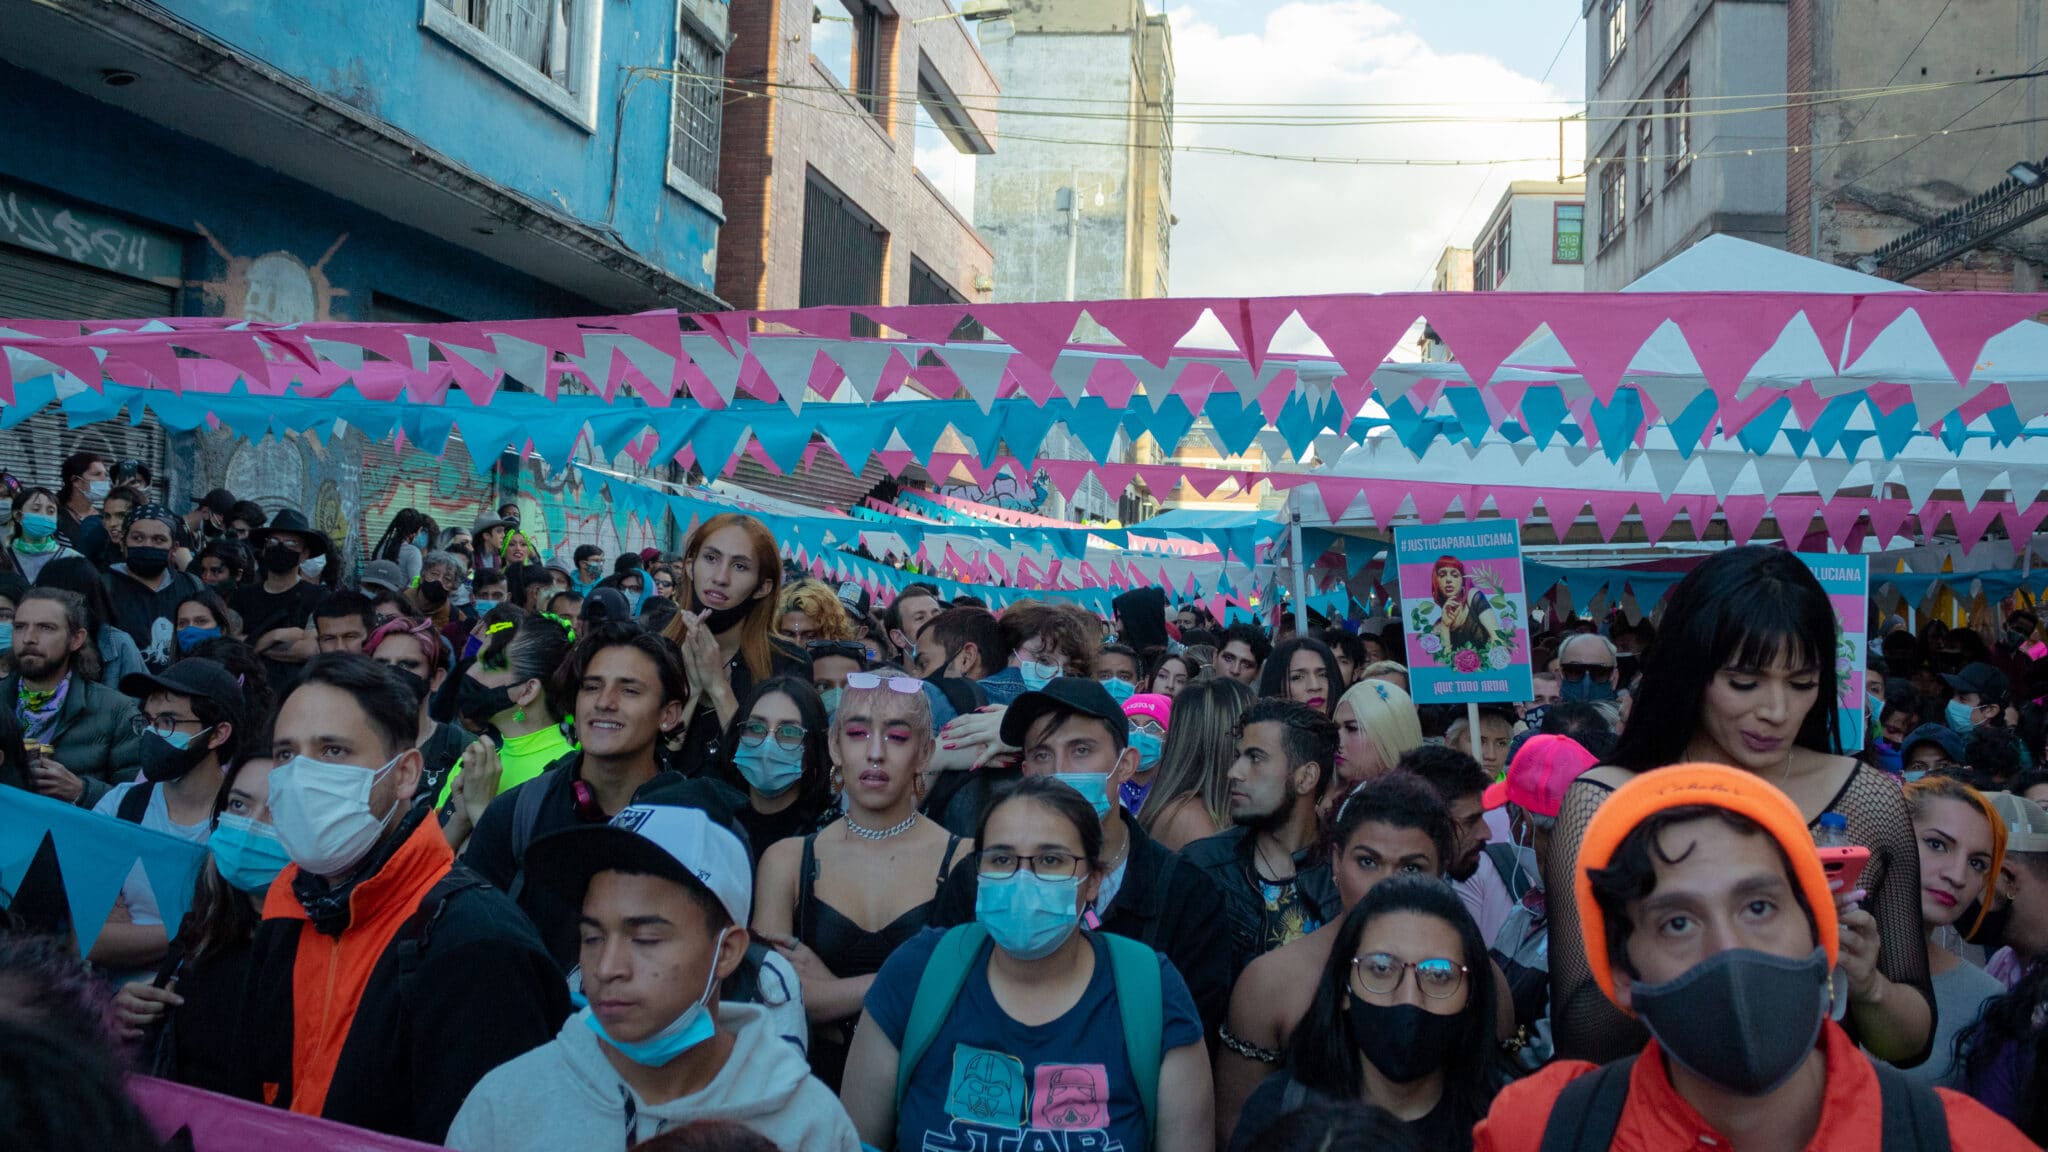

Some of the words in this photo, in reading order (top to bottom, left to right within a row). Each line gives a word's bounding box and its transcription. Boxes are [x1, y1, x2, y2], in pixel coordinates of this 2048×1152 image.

[1401, 532, 1514, 552] #JUSTICIAPARALUCIANA
[1455, 681, 1478, 693] TODO
[1481, 680, 1509, 693] ARDA!
[922, 1118, 1124, 1152] STAR
